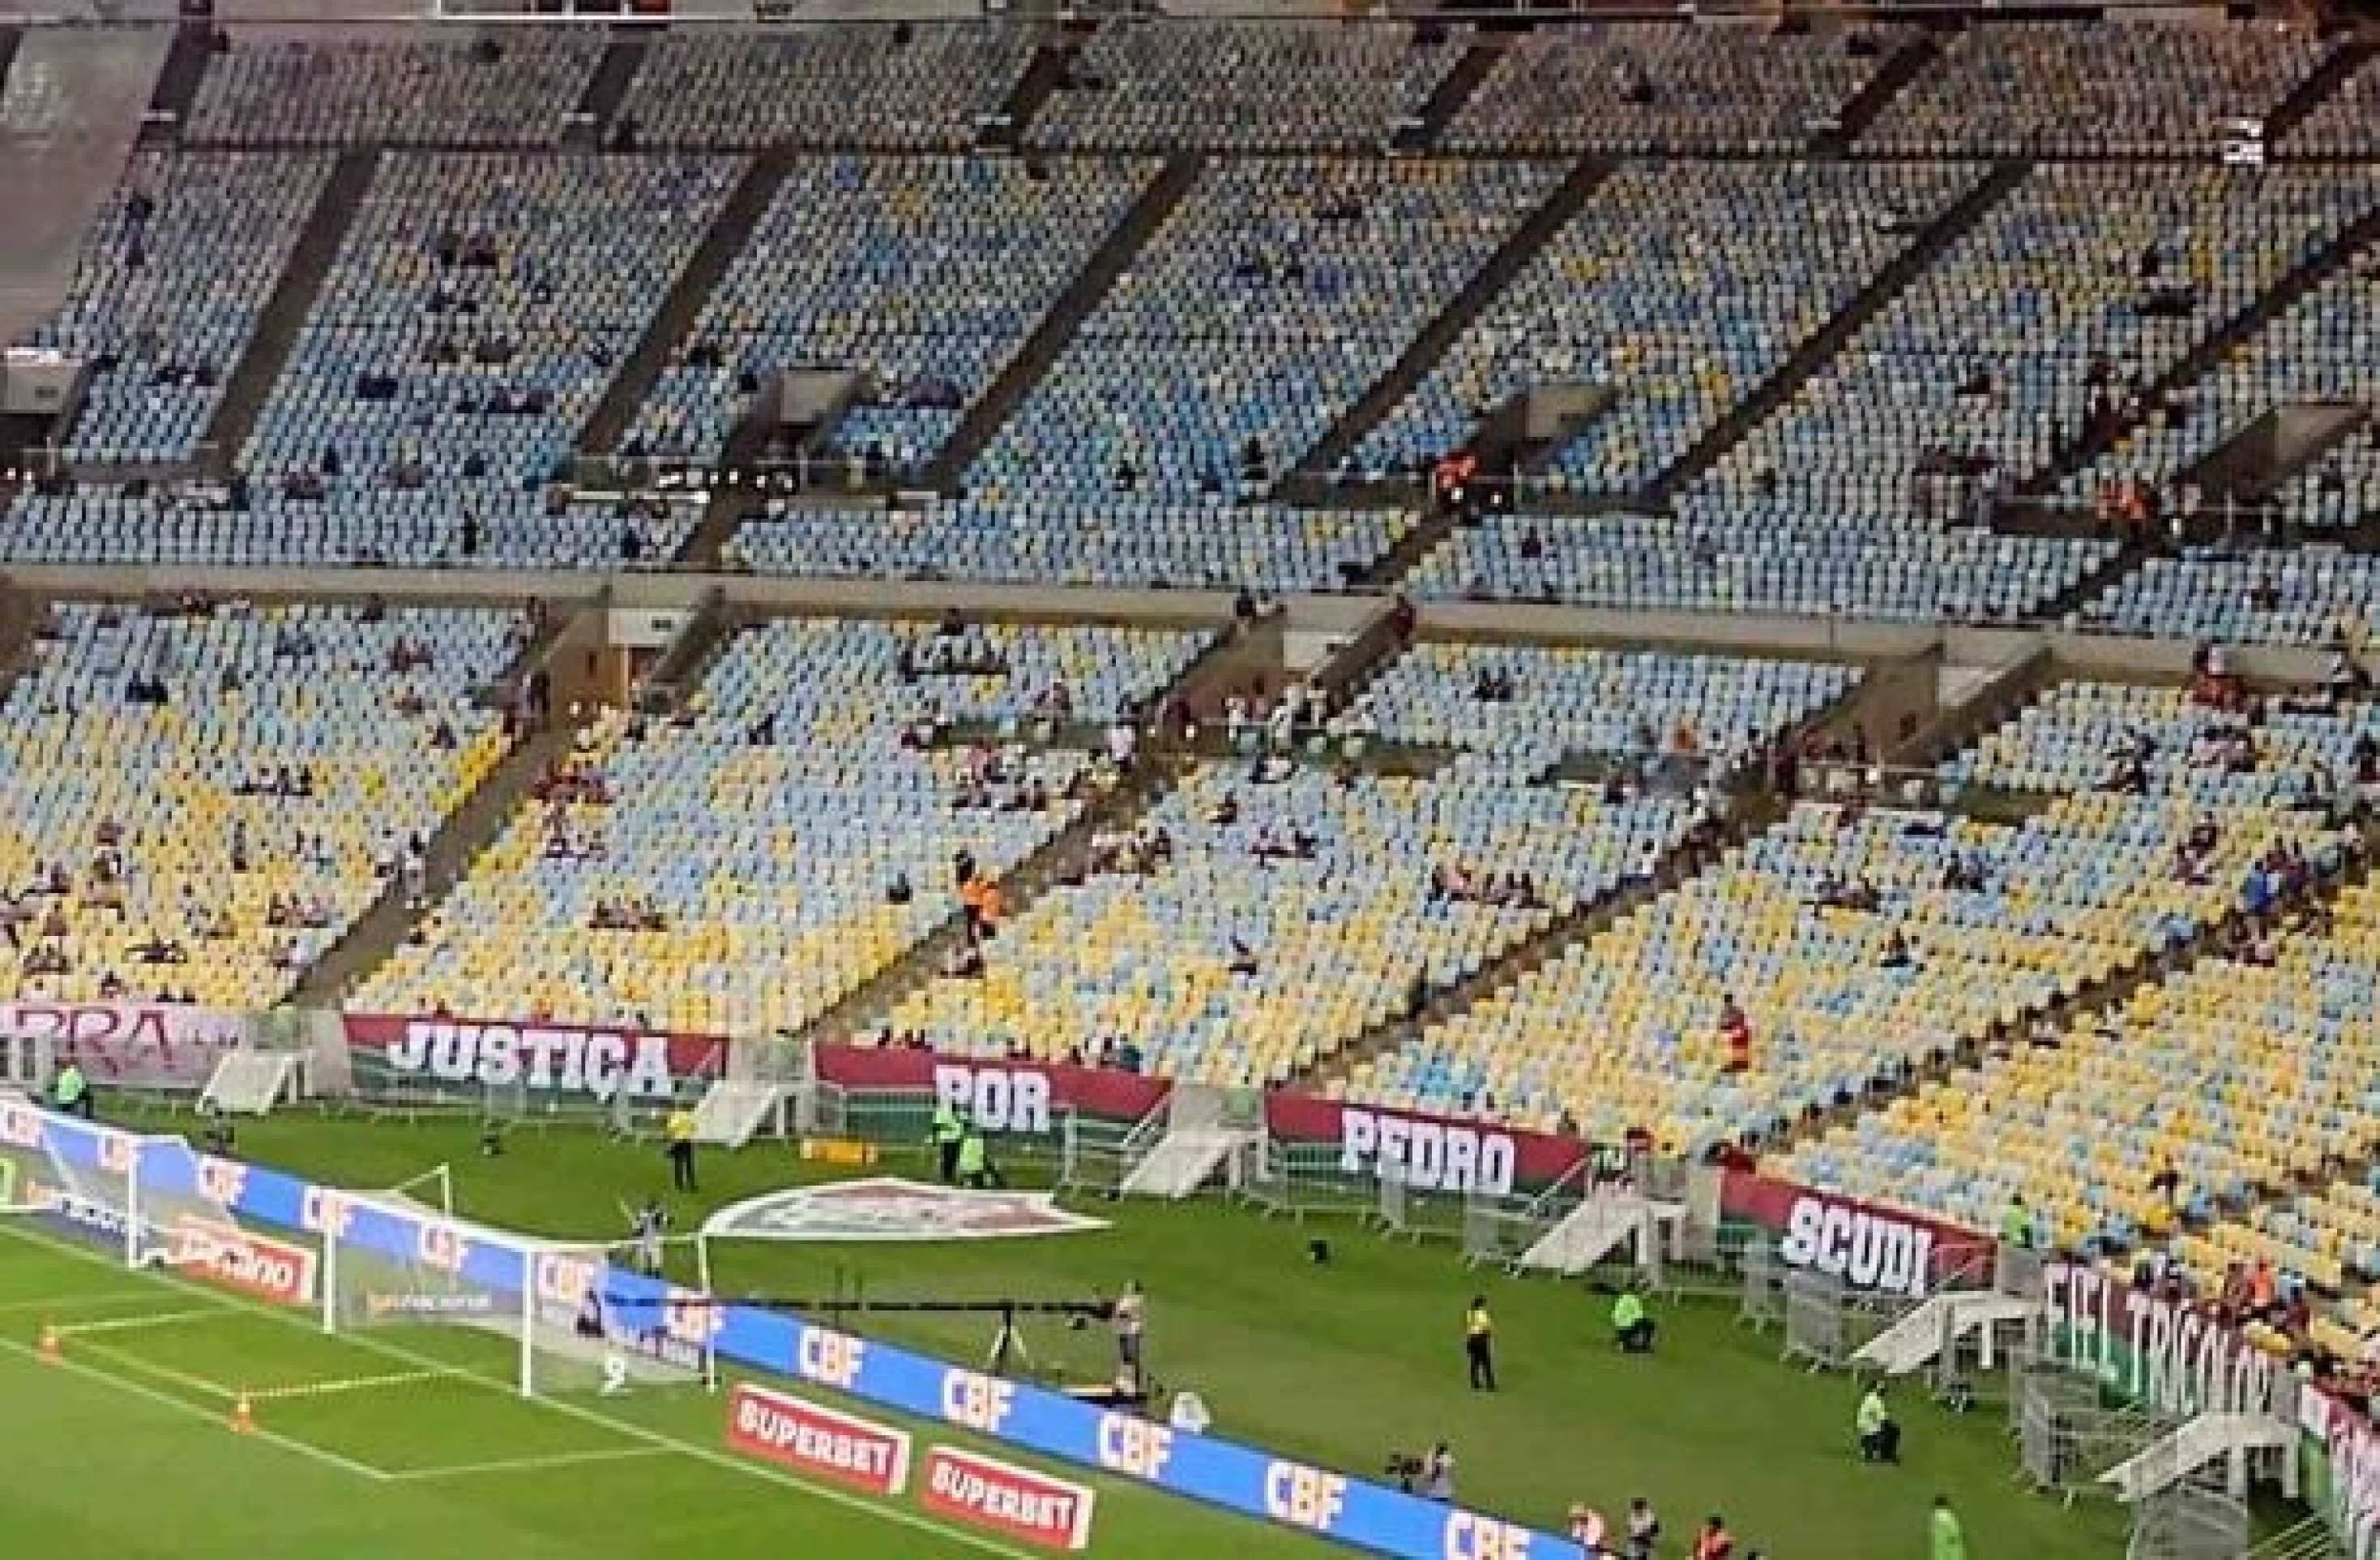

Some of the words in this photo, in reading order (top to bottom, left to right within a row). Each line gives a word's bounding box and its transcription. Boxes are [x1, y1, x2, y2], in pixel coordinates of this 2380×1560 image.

[936, 1064, 1050, 1133] POR
[1341, 1109, 1514, 1194] PEDRO
[1783, 1197, 1932, 1299] SCUDI
[798, 1325, 864, 1389] CBF
[943, 1367, 1015, 1433] CBF
[737, 1399, 891, 1477] SUPERBET
[1100, 1411, 1172, 1480] CBF
[931, 1462, 1075, 1531] SUPERBET
[1267, 1461, 1347, 1530] CBF
[1446, 1510, 1530, 1560] CBF
